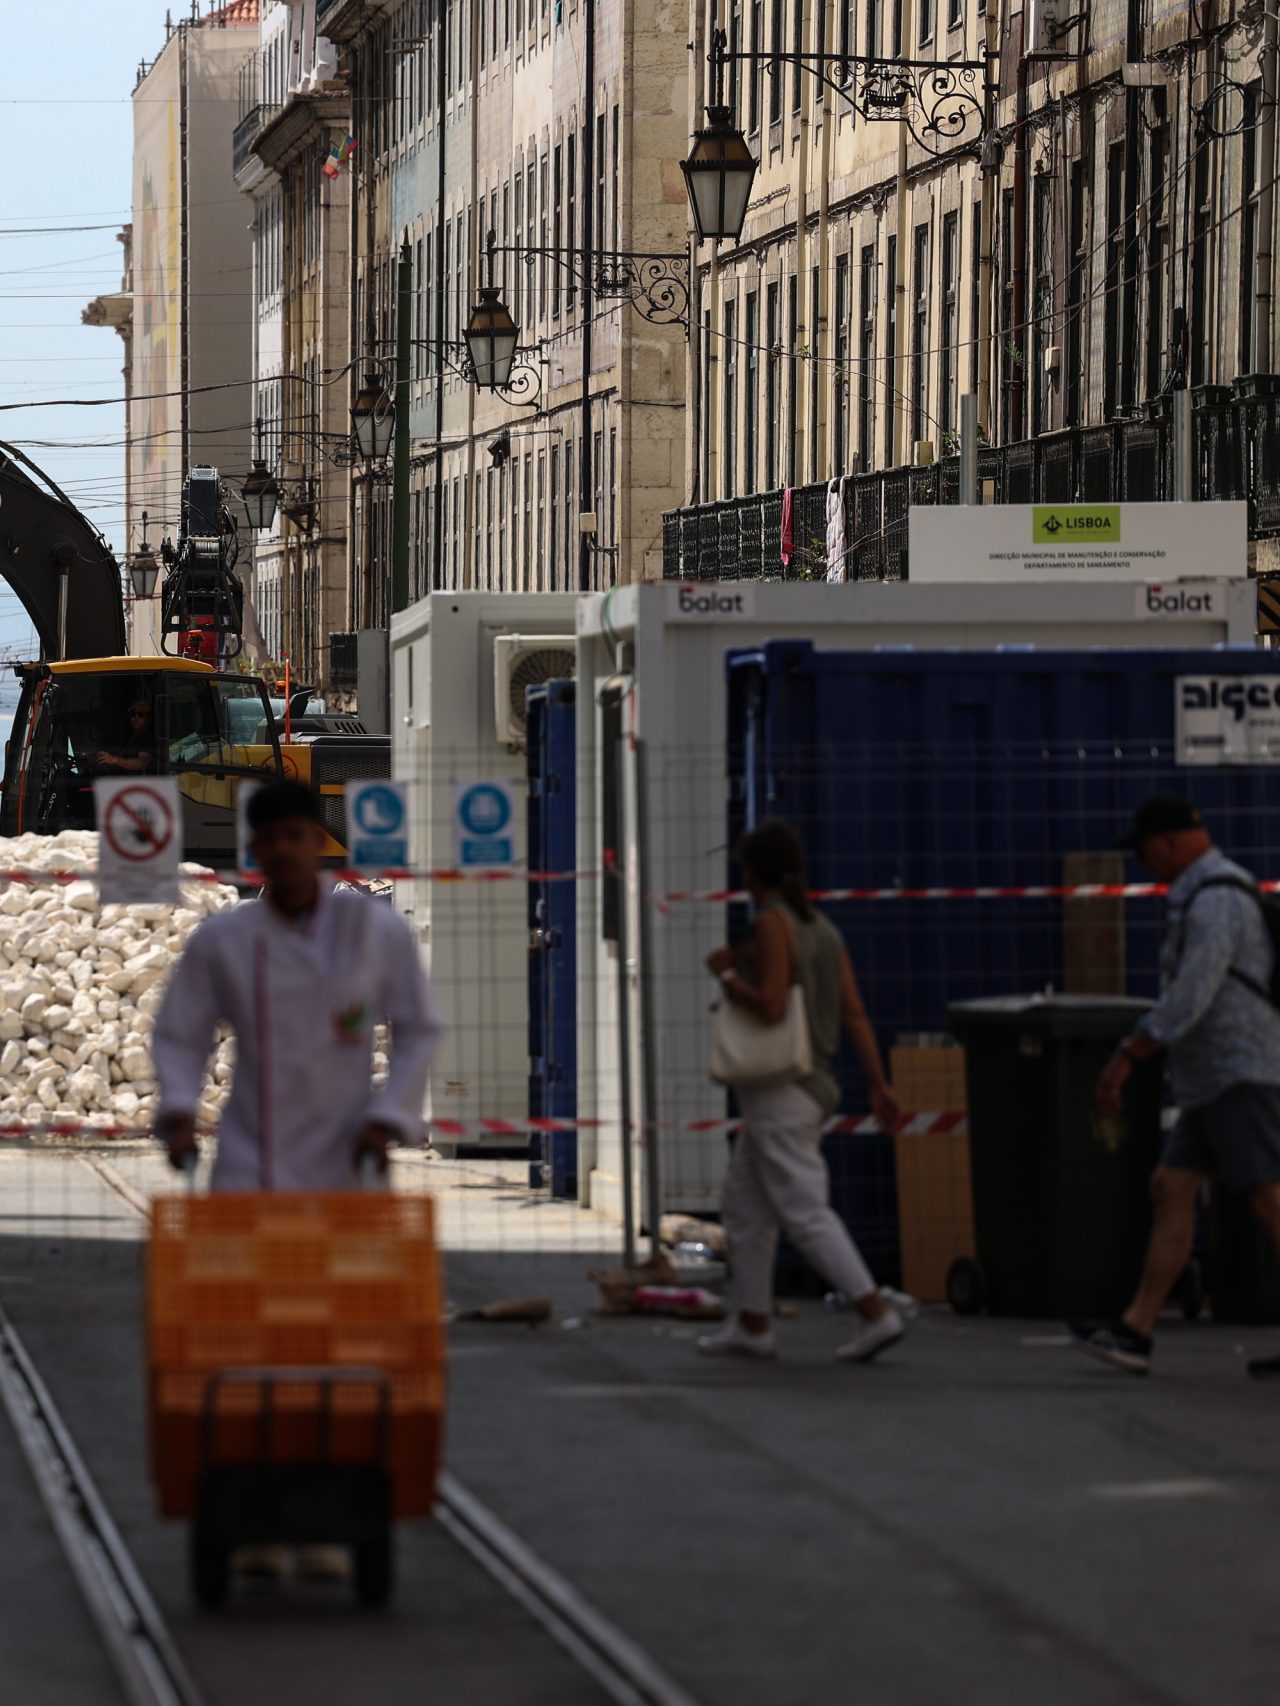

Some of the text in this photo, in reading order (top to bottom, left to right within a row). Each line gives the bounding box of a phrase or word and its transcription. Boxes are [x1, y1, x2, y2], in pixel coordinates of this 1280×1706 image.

[1066, 517, 1112, 529] LISBOA
[1022, 552, 1056, 560] MUNICIPAL
[1067, 551, 1112, 560] MANUTENÇÃO
[1119, 549, 1166, 560] CONSERVAÇÃO
[1024, 562, 1076, 570] DEPARTAMENTO
[679, 587, 743, 612] balat
[1147, 586, 1212, 612] balat
